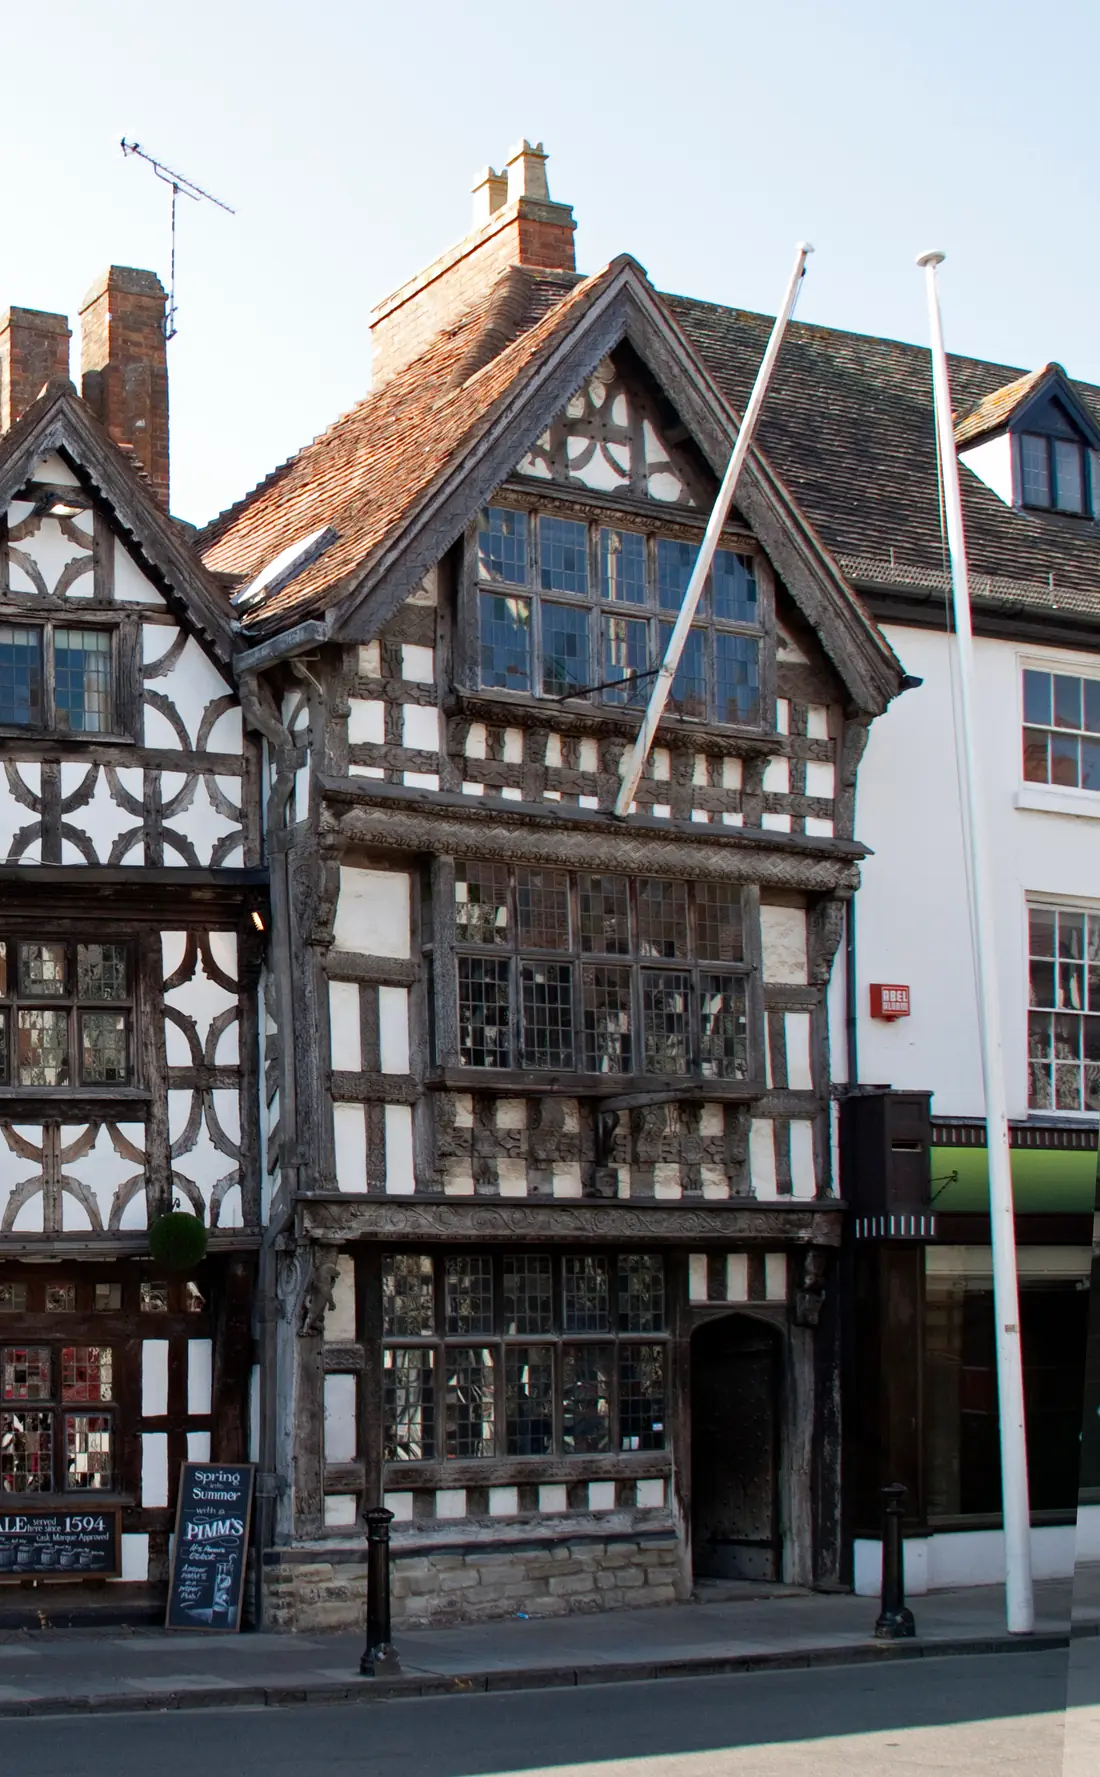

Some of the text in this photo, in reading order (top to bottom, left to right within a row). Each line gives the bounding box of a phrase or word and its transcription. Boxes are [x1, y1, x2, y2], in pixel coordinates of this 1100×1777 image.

[882, 990, 907, 1001] ABEL
[194, 1471, 241, 1486] Spring
[192, 1487, 241, 1501] Summer
[196, 1506, 216, 1515] with
[27, 1516, 106, 1533] here since 1594
[33, 1517, 57, 1526] served
[185, 1518, 244, 1540] PIMM'S
[52, 1532, 77, 1543] Marque
[79, 1532, 109, 1542] Approved
